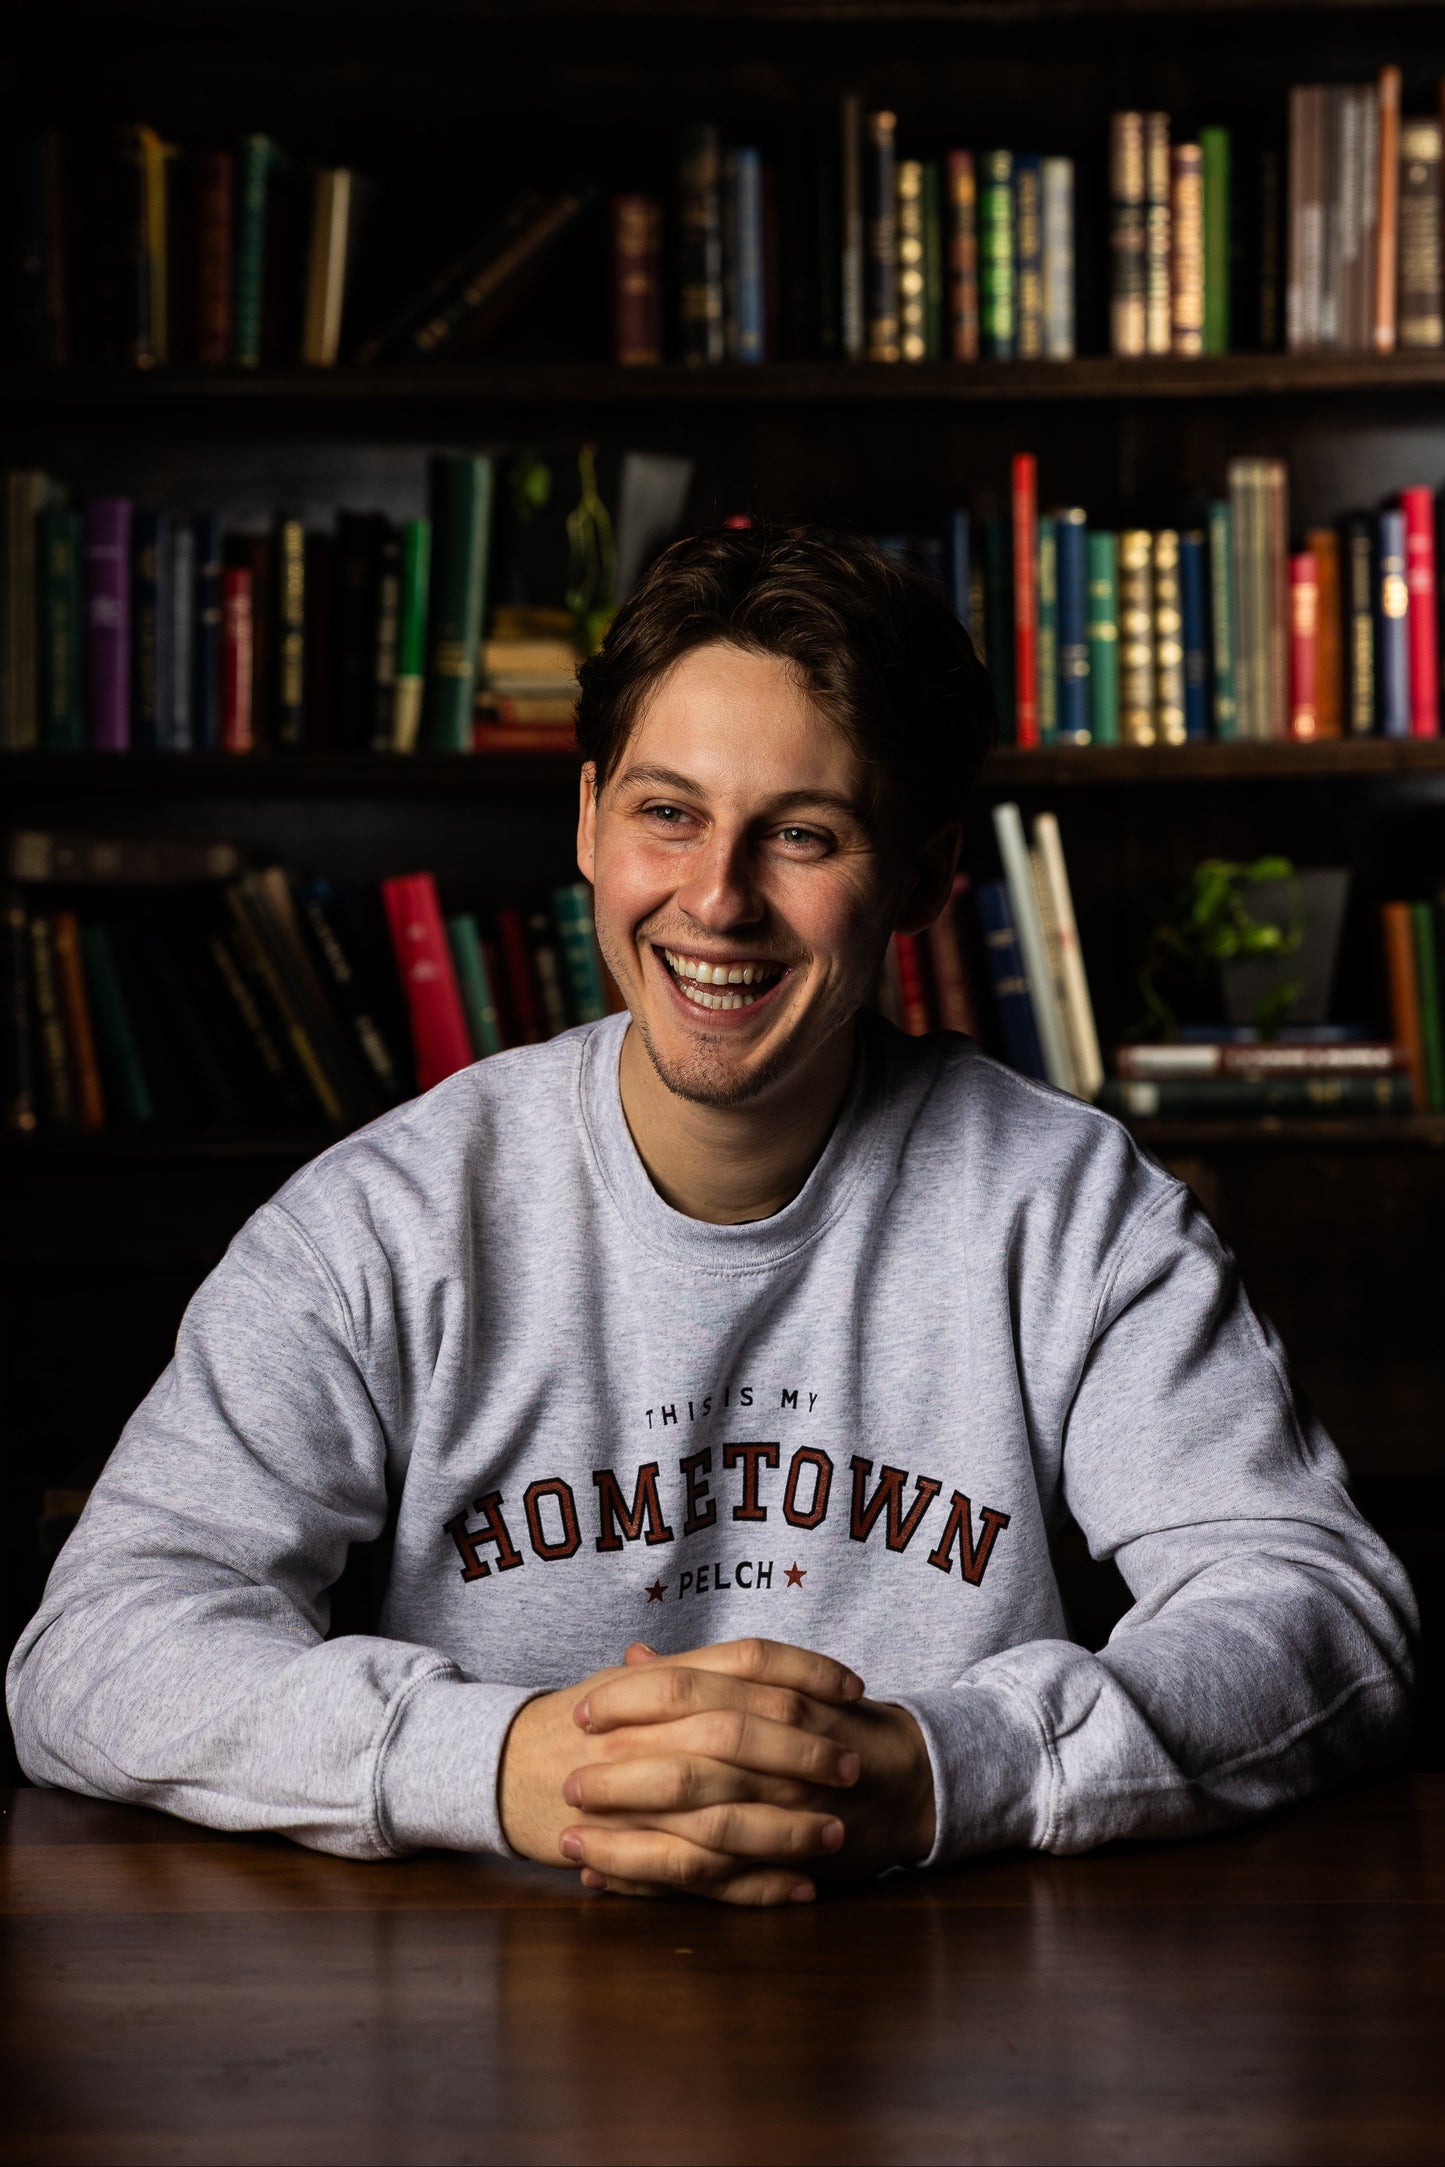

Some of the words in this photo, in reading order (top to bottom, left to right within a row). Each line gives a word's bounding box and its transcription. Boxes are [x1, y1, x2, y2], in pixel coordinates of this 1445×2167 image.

[645, 1396, 712, 1430] THIS
[724, 1386, 754, 1407] IS
[780, 1388, 818, 1413] MY
[442, 1442, 1011, 1587] HOMETOWN
[678, 1560, 774, 1600] PELCH
